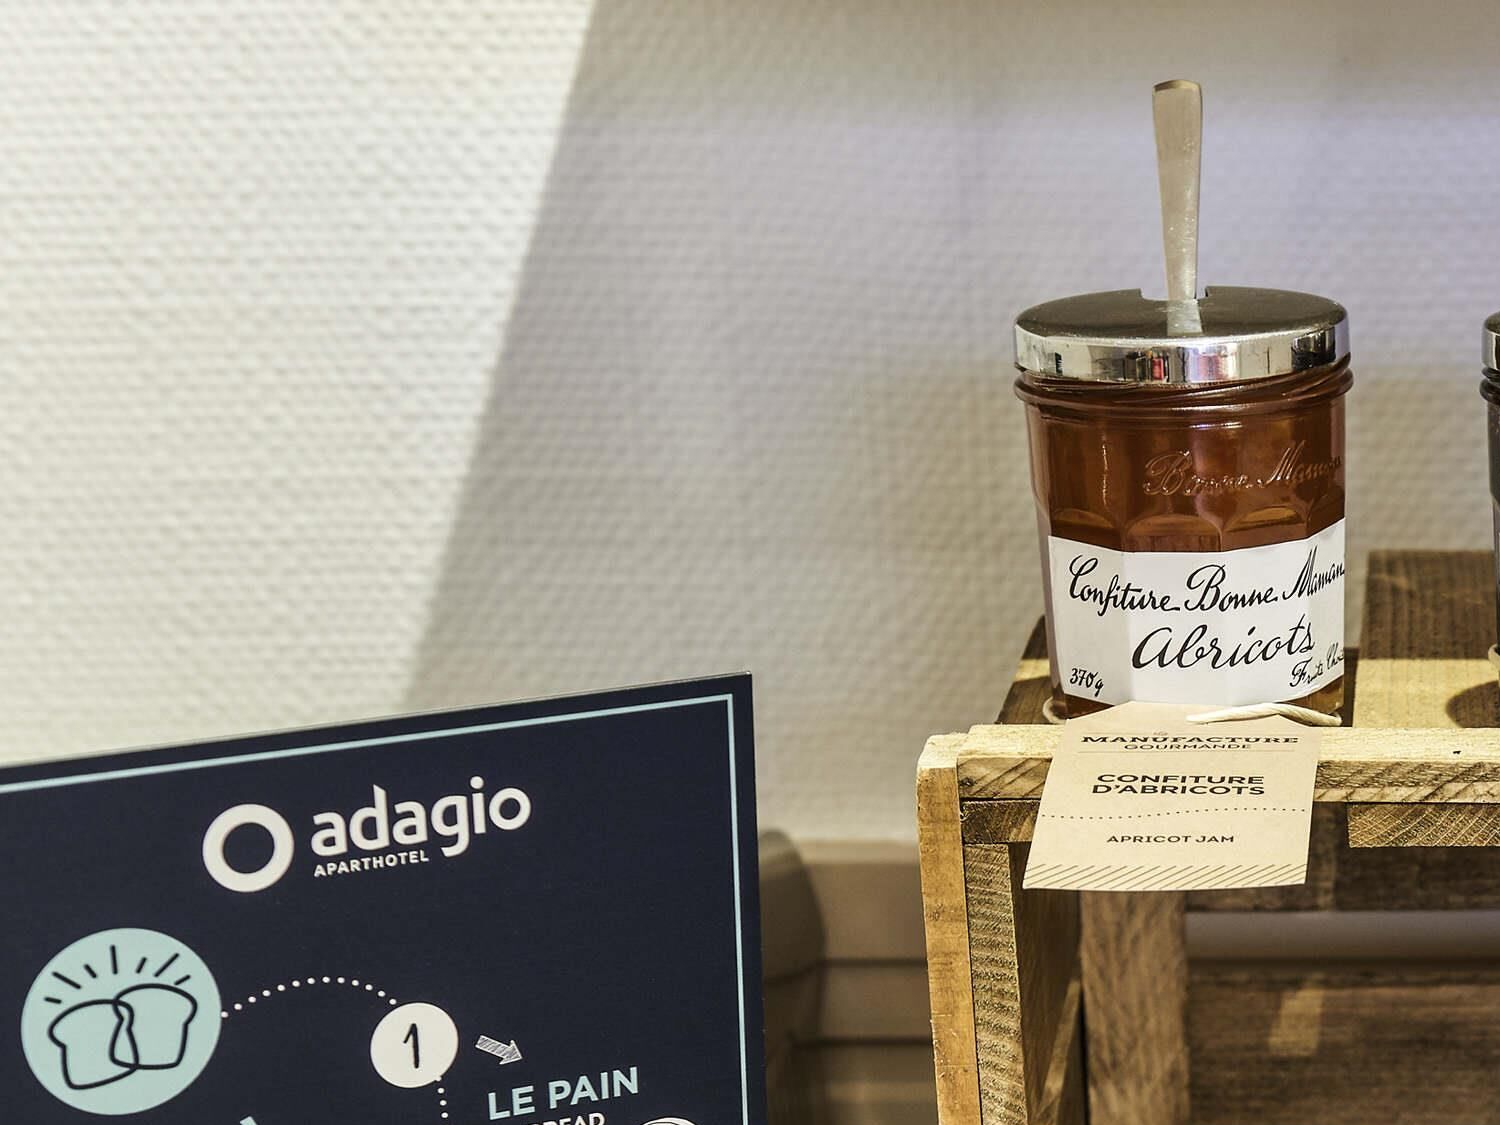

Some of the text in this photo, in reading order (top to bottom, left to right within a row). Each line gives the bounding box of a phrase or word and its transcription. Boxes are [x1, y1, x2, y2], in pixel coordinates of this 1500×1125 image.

[1069, 545, 1345, 616] Confiture Bonne Maman
[1080, 736, 1299, 744] MANUFACTURE
[1092, 784, 1266, 796] D’ABRICOTS
[1097, 774, 1266, 785] CONFITURE
[311, 776, 532, 858] adagio
[1106, 835, 1235, 843] APRICOT JAM
[314, 850, 430, 877] APARTHOTEL
[403, 1023, 421, 1068] 1
[488, 1066, 639, 1121] LE PAIN
